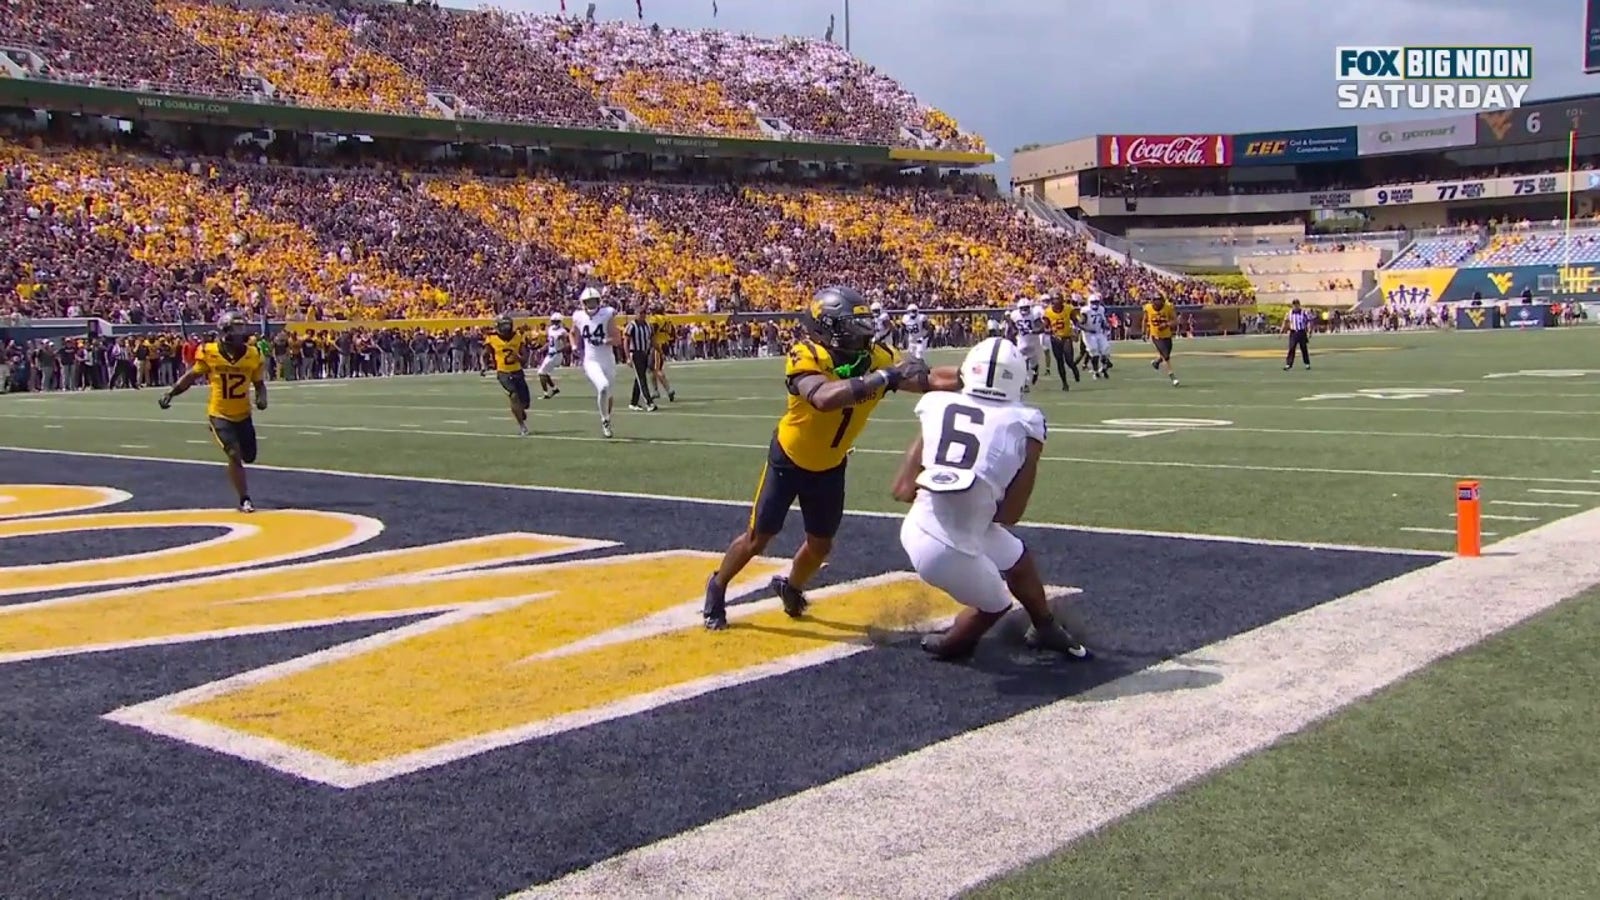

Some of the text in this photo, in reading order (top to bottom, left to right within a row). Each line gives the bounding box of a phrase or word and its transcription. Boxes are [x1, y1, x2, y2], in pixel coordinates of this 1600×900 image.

[136, 97, 229, 113] VISIT GOMART.COM
[1526, 112, 1541, 133] 6
[1126, 137, 1207, 165] Coca-Cola
[1245, 141, 1287, 156] CEC
[1437, 185, 1458, 200] 77
[1513, 179, 1535, 194] 75
[1378, 190, 1388, 205] 9
[582, 323, 605, 340] 44
[502, 348, 516, 365] 2
[220, 373, 246, 399] 12
[830, 407, 854, 448] 1
[934, 402, 985, 470] 6
